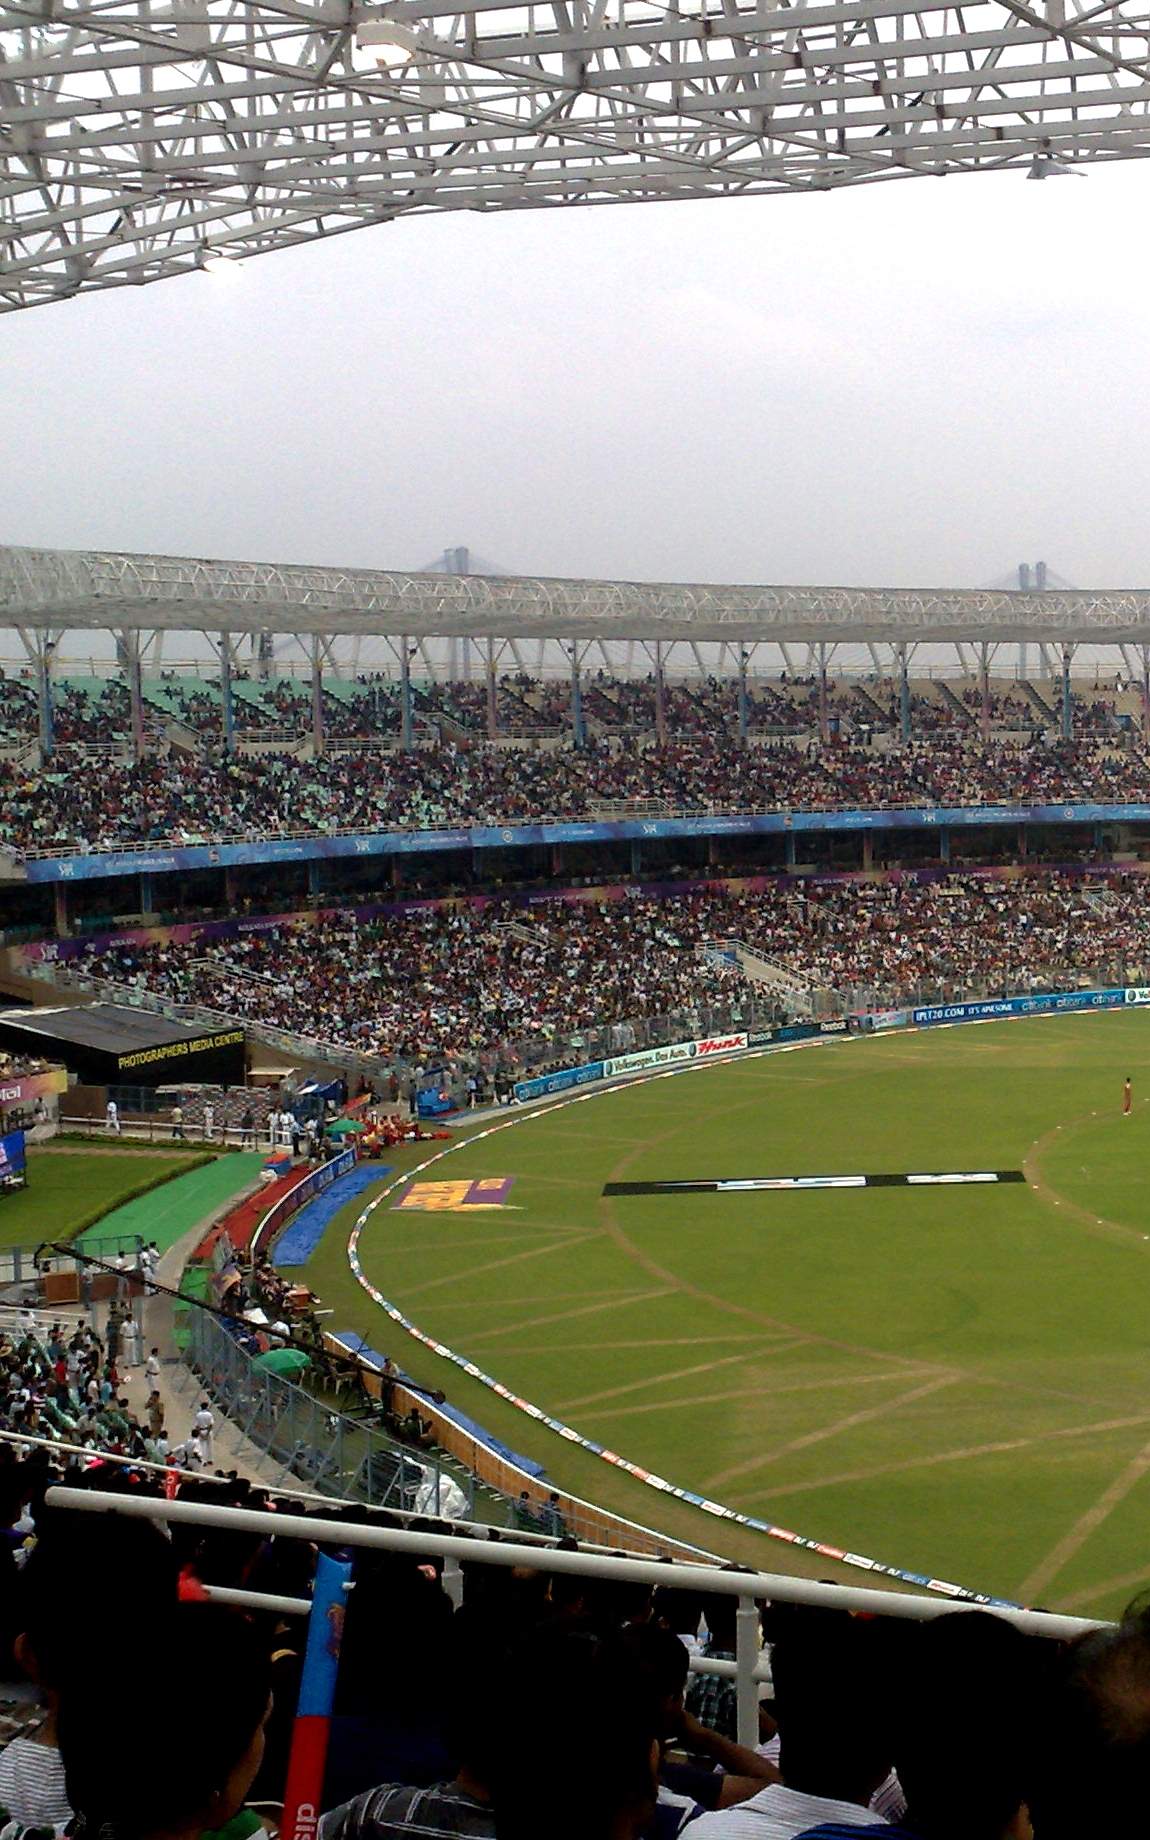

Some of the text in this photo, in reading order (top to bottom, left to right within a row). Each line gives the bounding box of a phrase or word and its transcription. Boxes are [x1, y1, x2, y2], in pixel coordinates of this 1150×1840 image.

[188, 1037, 214, 1053] MEDIA
[214, 1030, 245, 1047] CENTRE
[697, 1036, 746, 1055] Hunk
